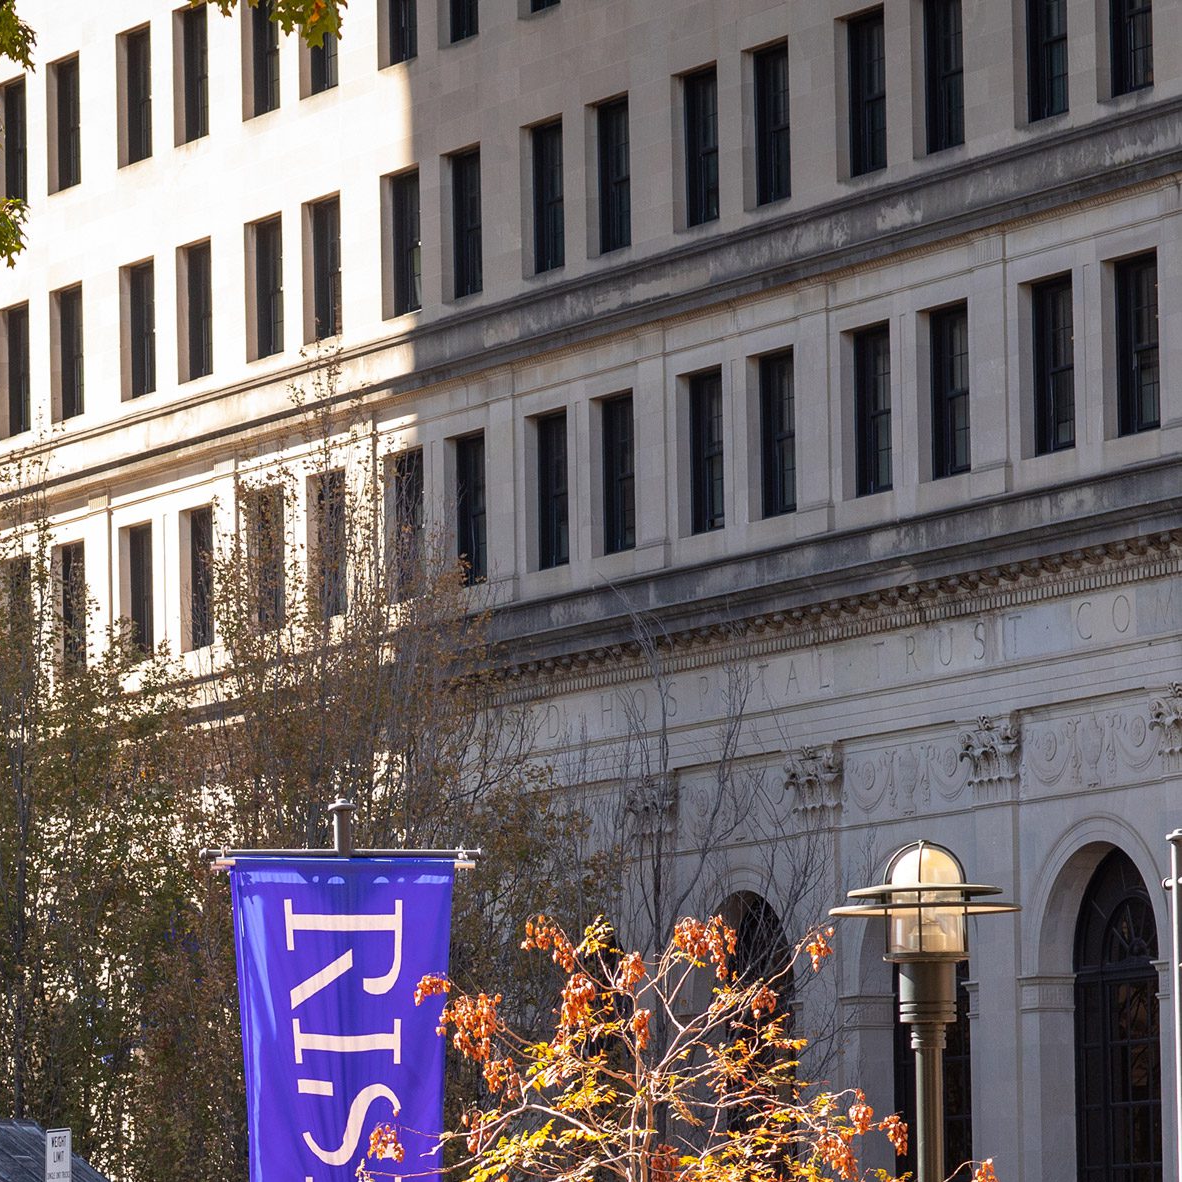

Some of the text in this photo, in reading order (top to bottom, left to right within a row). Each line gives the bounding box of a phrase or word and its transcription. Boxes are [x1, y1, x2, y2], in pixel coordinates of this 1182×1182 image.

[600, 652, 831, 730] HOSPTAL
[872, 614, 1022, 680] TRUST
[51, 1136, 66, 1147] WEIGHT
[53, 1151, 64, 1163] LIMIT
